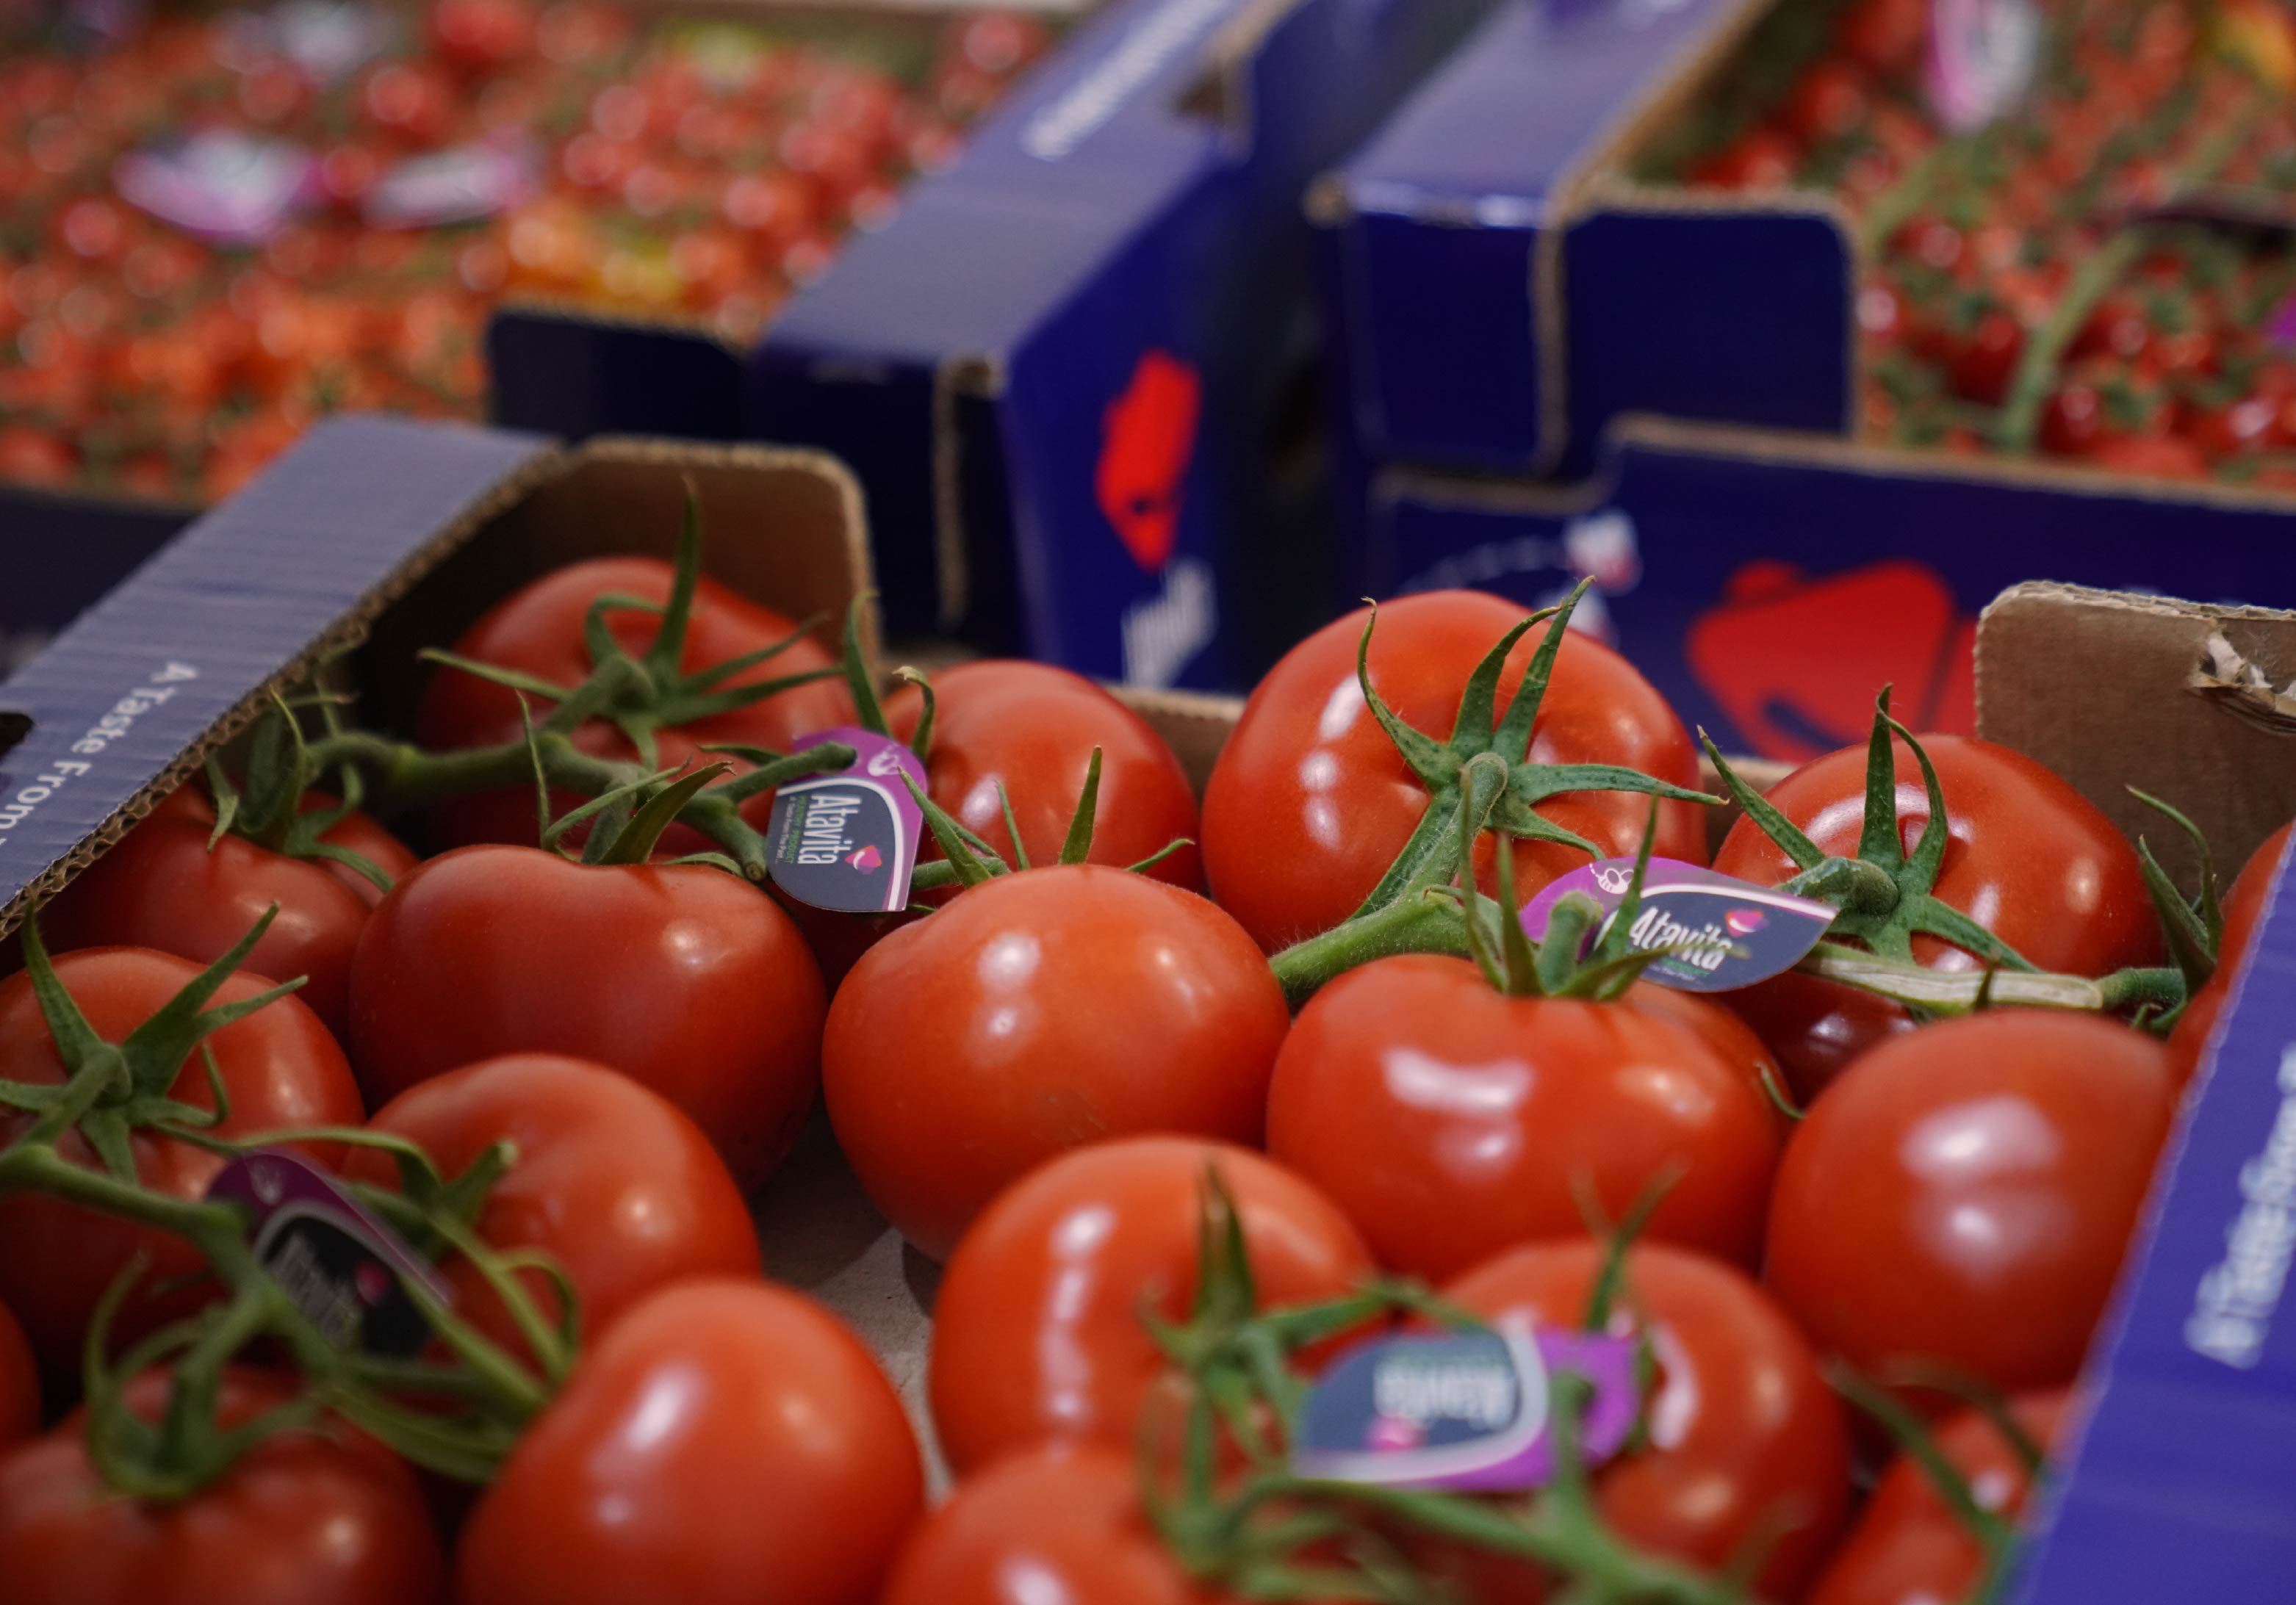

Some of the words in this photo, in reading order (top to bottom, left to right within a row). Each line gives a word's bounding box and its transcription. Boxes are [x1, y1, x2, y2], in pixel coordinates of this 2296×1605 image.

[150, 662, 197, 683] A
[70, 687, 177, 754] Taste
[0, 760, 92, 829] From
[797, 794, 862, 865] Atavita
[1629, 905, 1733, 971] Atavita
